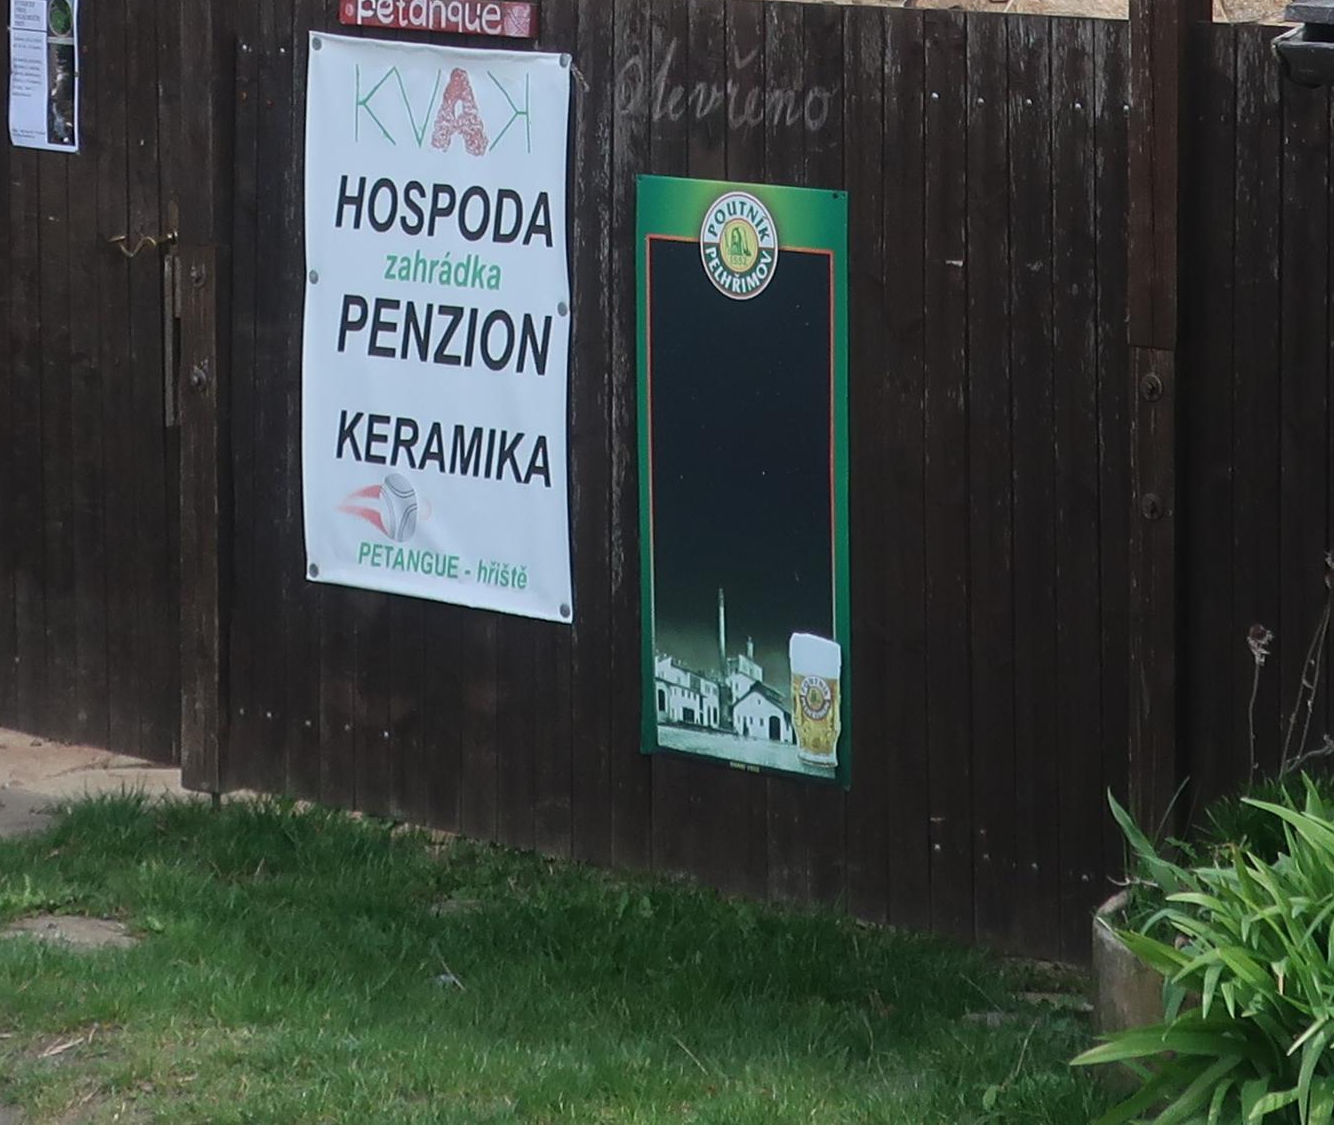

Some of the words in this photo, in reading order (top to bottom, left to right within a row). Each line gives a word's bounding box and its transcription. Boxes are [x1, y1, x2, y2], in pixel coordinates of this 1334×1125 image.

[354, 63, 531, 157] KVAK
[334, 174, 554, 249] HOSPODA
[707, 200, 770, 243] POUTNÍK
[383, 249, 502, 291] zahrádka
[705, 246, 772, 293] PELHŘIMOV
[337, 293, 553, 377] PENZION
[335, 409, 552, 488] KERAMIKA
[357, 541, 460, 579] PETANGUE
[476, 559, 528, 589] hřiště
